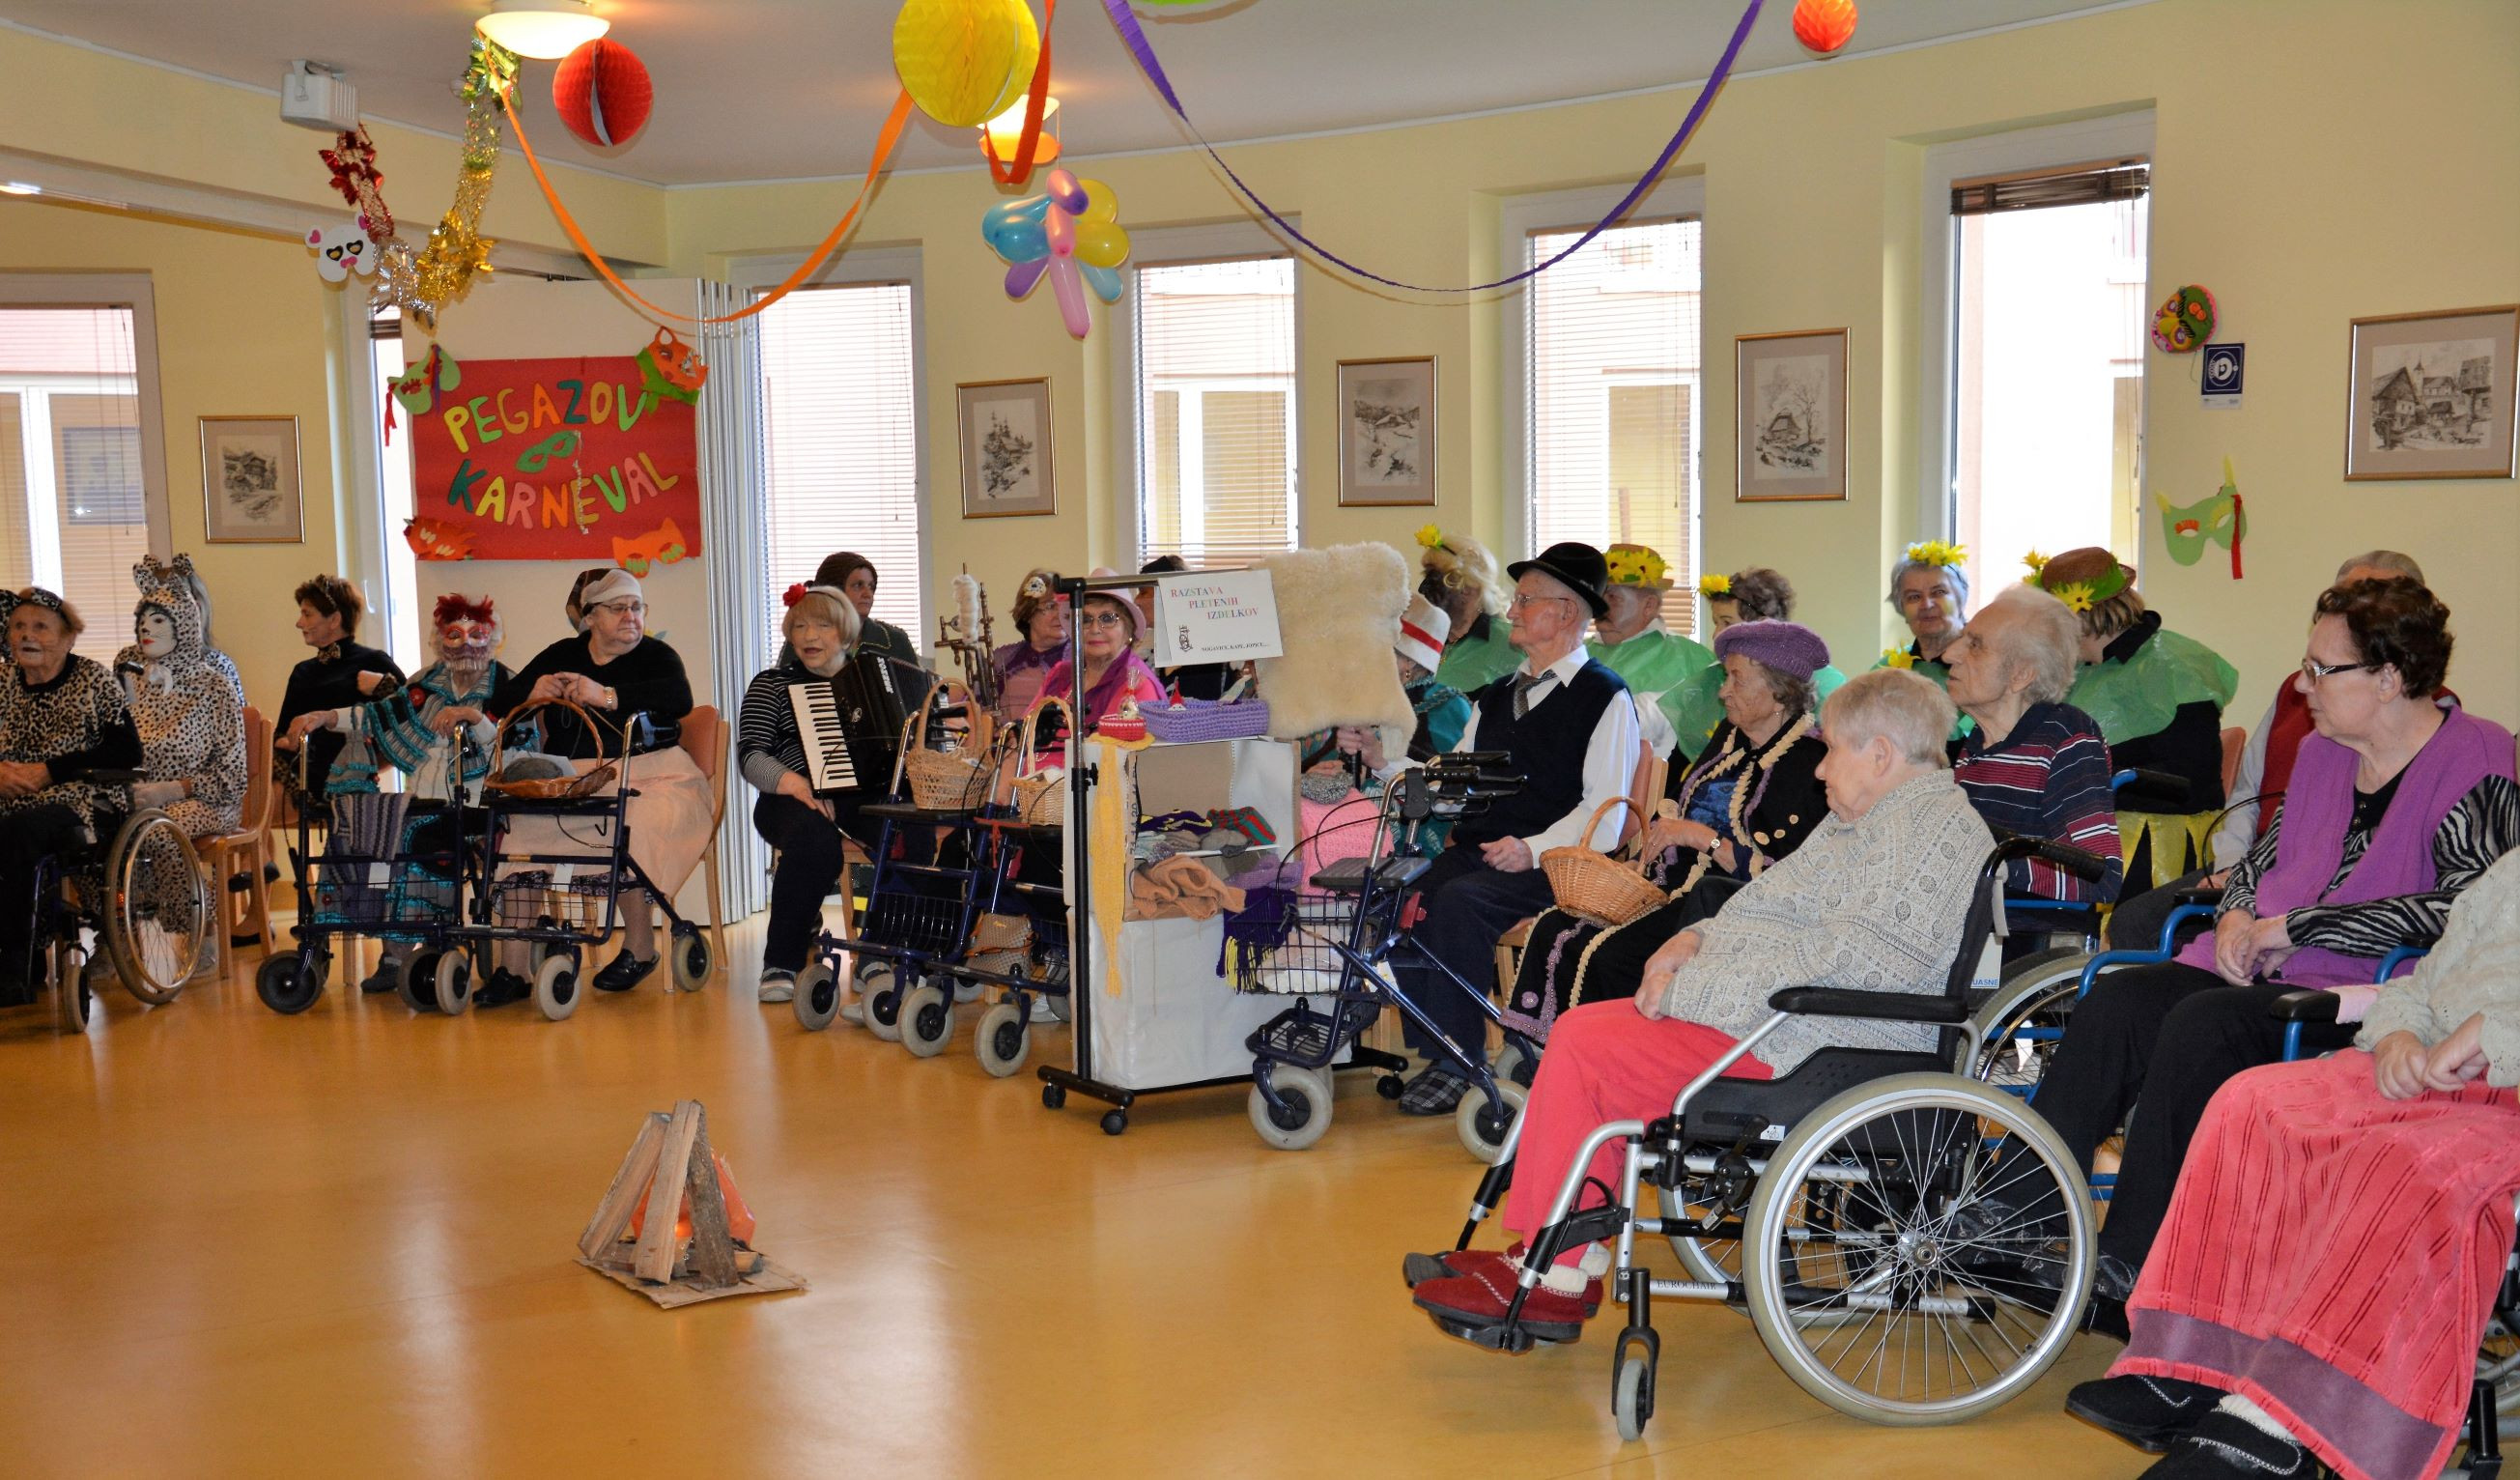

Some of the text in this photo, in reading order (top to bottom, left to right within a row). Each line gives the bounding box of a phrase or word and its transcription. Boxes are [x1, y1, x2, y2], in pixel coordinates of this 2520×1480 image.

[443, 380, 648, 453] PEGAZOV
[447, 452, 679, 529] KARNEVAL
[1171, 586, 1224, 598] RAZSTAVA
[1189, 597, 1238, 610] PLETENIH
[1207, 608, 1260, 620] IZDELKOV
[1656, 1280, 1716, 1290] EUROCHAIR
